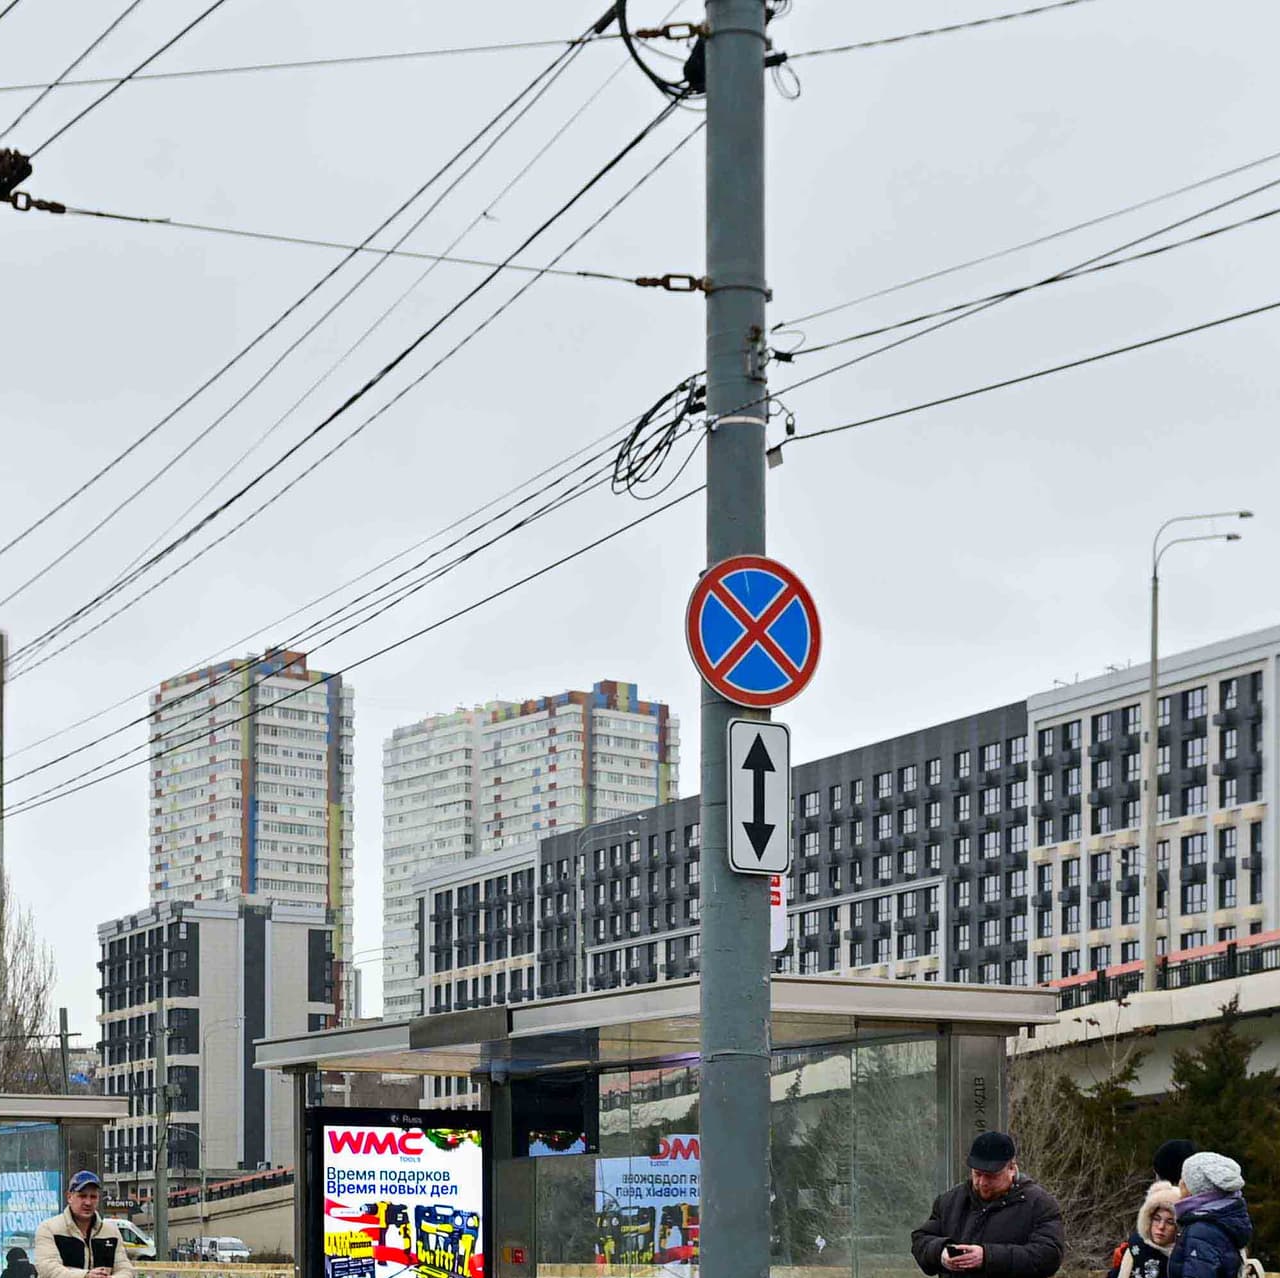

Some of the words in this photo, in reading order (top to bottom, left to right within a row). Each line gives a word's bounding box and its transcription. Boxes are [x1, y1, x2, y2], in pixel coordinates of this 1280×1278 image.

[974, 1076, 987, 1116] ЖДВ
[328, 1130, 425, 1156] WMC
[327, 1167, 375, 1183] Время
[380, 1170, 450, 1184] подарков
[327, 1181, 376, 1197] Время
[380, 1184, 426, 1195] новых
[430, 1184, 458, 1198] дел
[106, 1200, 134, 1208] PRONTO
